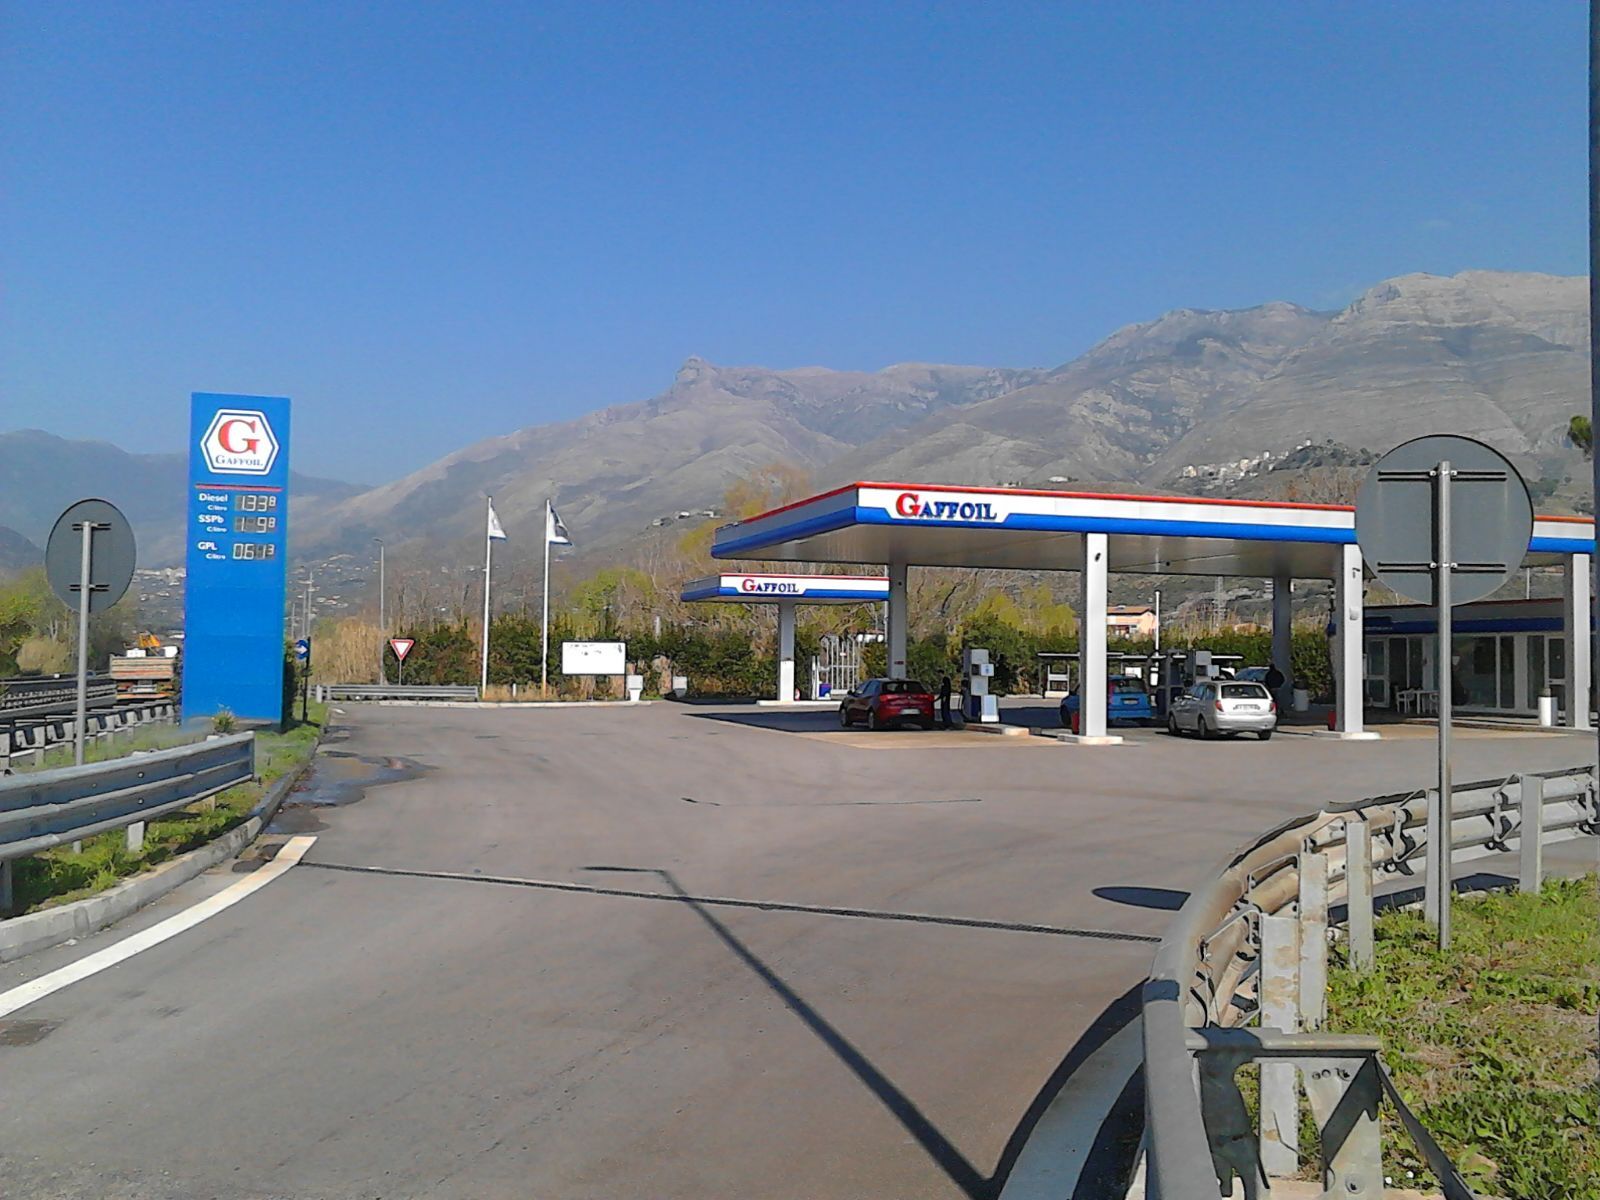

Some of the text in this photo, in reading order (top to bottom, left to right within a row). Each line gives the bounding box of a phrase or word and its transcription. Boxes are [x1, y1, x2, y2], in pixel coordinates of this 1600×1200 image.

[215, 454, 263, 467] GAFFOIL
[198, 493, 228, 502] Diesel
[895, 492, 997, 521] GAFFOIL
[197, 541, 218, 550] GPL
[741, 578, 800, 594] GAFFOIL
